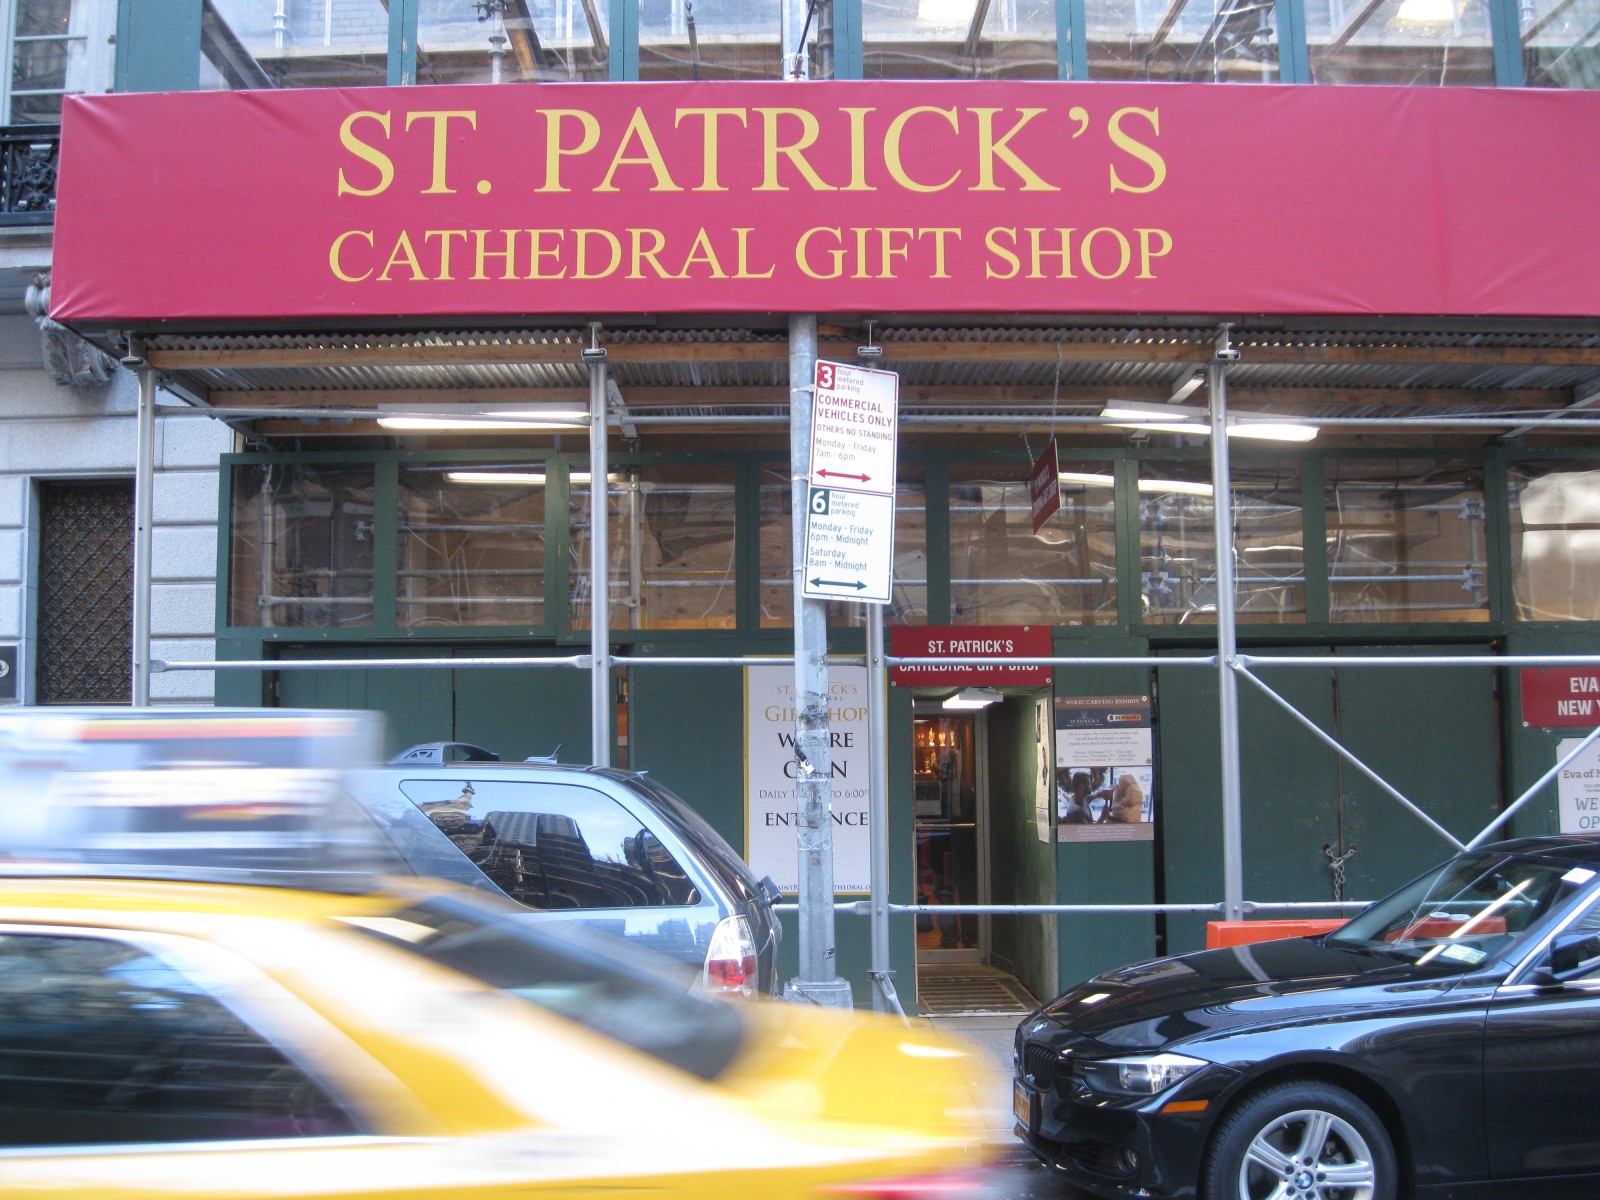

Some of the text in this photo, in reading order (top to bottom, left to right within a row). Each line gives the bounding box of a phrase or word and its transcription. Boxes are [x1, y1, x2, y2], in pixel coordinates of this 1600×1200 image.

[338, 105, 1167, 196] ST. PATRICK'S
[328, 226, 1173, 282] CATHEDRAL GIFT SHOP
[820, 366, 832, 388] 3
[838, 368, 851, 376] hour
[837, 376, 864, 385] metered
[837, 384, 860, 393] parking
[819, 395, 882, 413] COMMERCIAL
[818, 408, 892, 427] VEHICLES ONLY
[817, 424, 844, 434] OTHERS
[859, 431, 892, 441] STANDING
[816, 438, 845, 449] Monday
[854, 443, 876, 454] Friday
[816, 449, 831, 457] 7am
[839, 453, 855, 461] 6pm
[812, 491, 826, 512] 6
[831, 508, 855, 517] parking
[811, 522, 842, 533] Monday
[850, 525, 873, 536] Friday
[811, 533, 828, 542] 6pm
[836, 535, 868, 546] Midnight
[810, 547, 846, 559] Saturday
[809, 558, 826, 567] 8am
[835, 561, 867, 571] Midnight
[928, 640, 1013, 653] ST. PATRICK'S
[1570, 677, 1598, 692] EVA
[1558, 700, 1592, 715] NEW
[830, 732, 853, 747] RE
[1563, 770, 1581, 778] Eva
[1584, 769, 1594, 778] of
[759, 790, 788, 798] DAILY
[765, 812, 868, 826] ENTNCE
